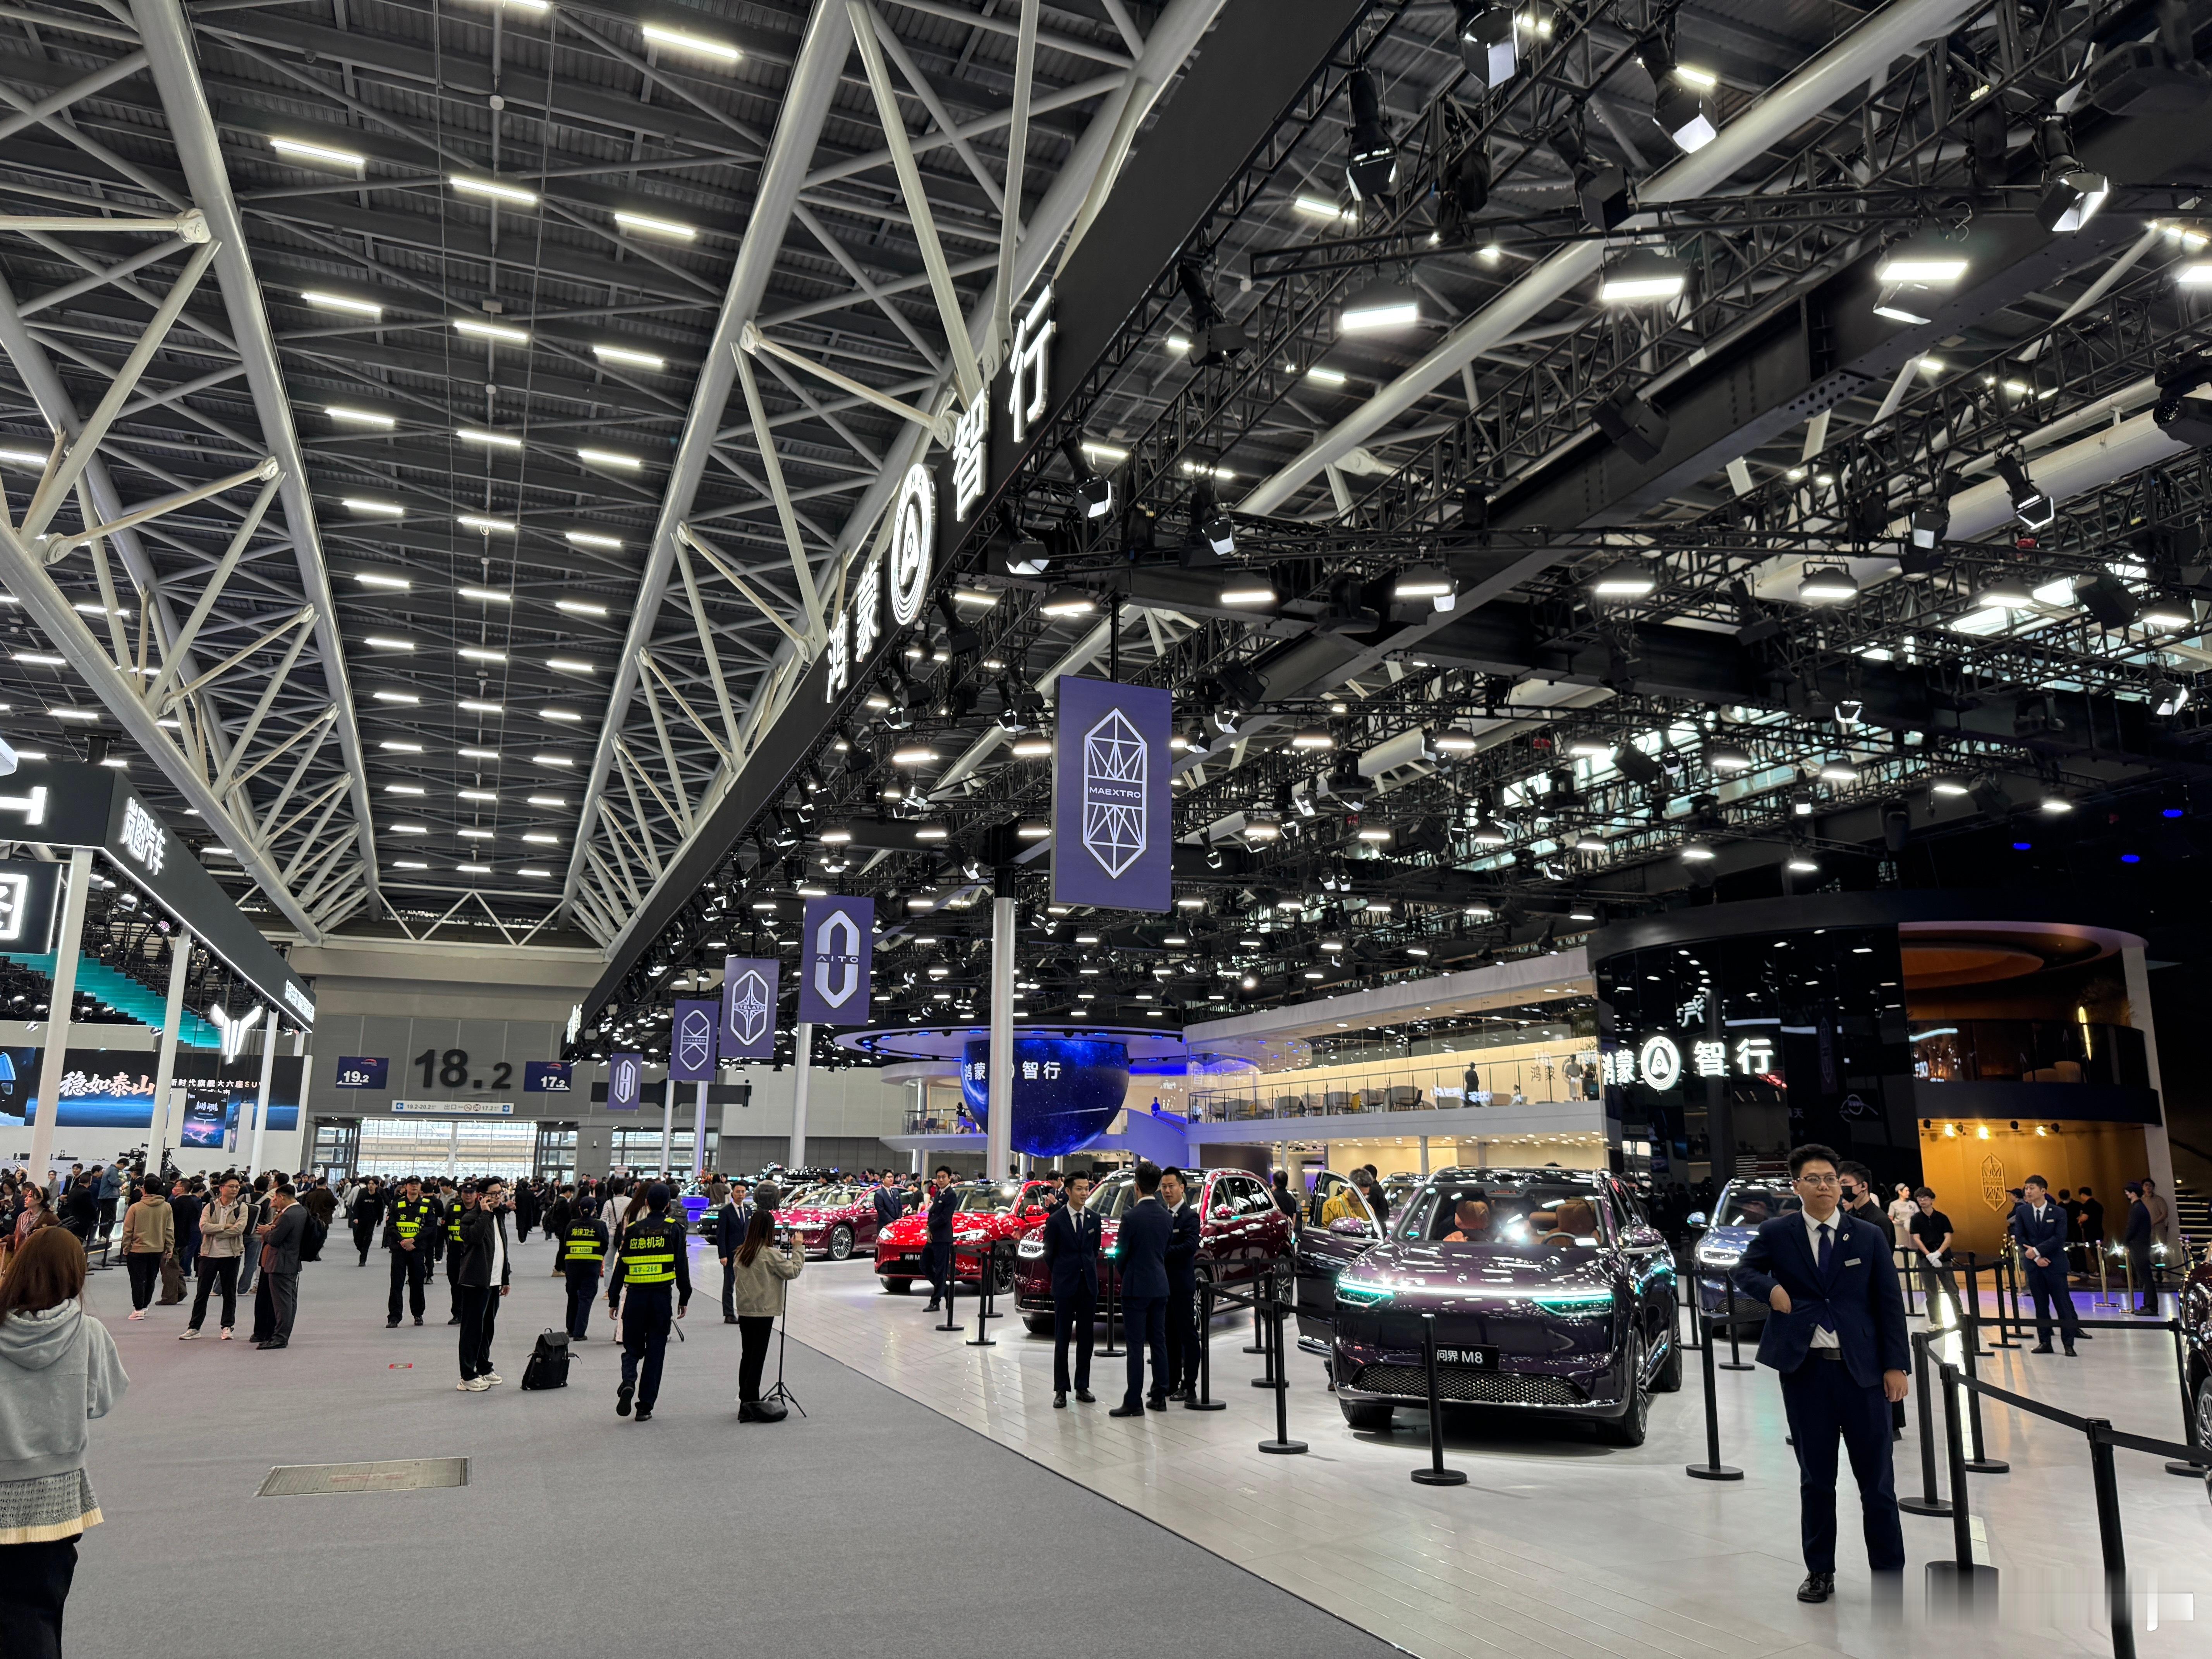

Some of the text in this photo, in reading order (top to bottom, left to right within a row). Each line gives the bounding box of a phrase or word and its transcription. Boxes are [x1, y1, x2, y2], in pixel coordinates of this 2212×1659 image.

[953, 285, 1056, 522] 智行
[1089, 787, 1141, 799] MAEXTRO
[121, 796, 166, 876] 岚图汽车
[816, 955, 859, 963] AITO
[415, 1048, 512, 1089] 18.2
[1602, 1049, 1635, 1085] 鸿蒙
[1693, 1038, 1774, 1077] 智行
[343, 1070, 369, 1083] 19.2
[1022, 1061, 1061, 1080] 智行
[59, 1070, 155, 1097] 稳如泰山
[541, 1076, 565, 1087] 17.2
[630, 1236, 665, 1249] 应急机动
[1437, 1349, 1483, 1364] 问界 M8
